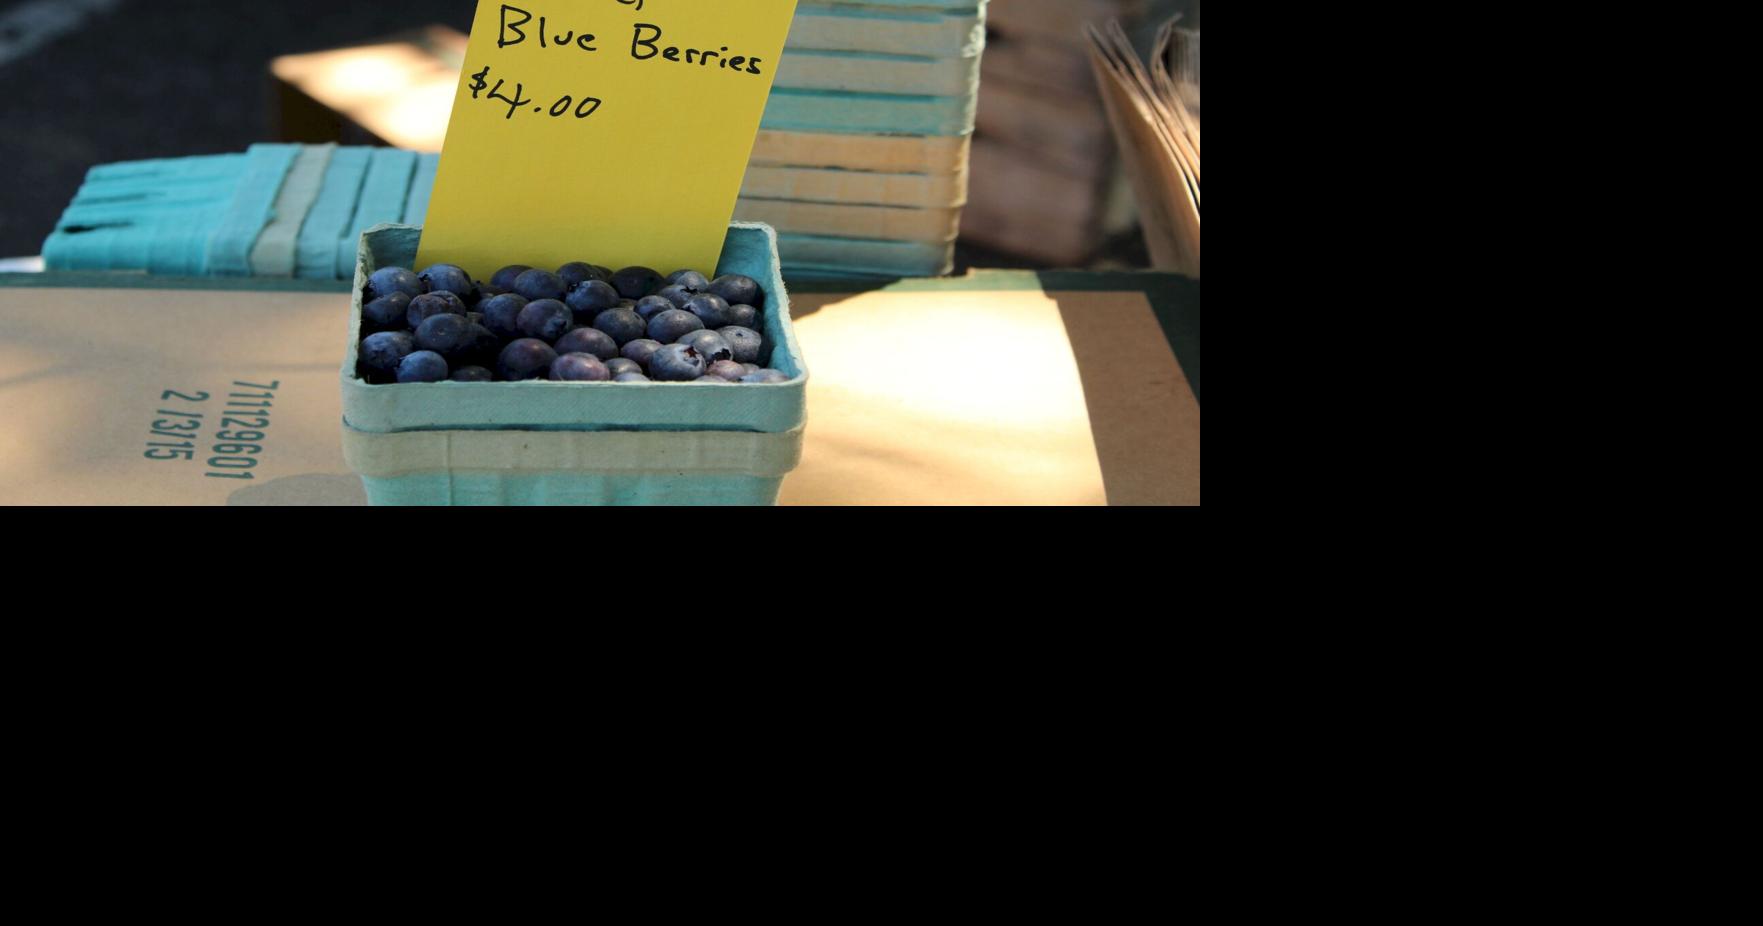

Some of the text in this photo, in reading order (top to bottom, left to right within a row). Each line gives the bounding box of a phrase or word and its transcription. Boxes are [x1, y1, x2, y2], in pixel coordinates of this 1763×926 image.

[498, 4, 762, 75] Blue Berries
[468, 66, 602, 120] $4.00
[204, 380, 280, 480] 711129601
